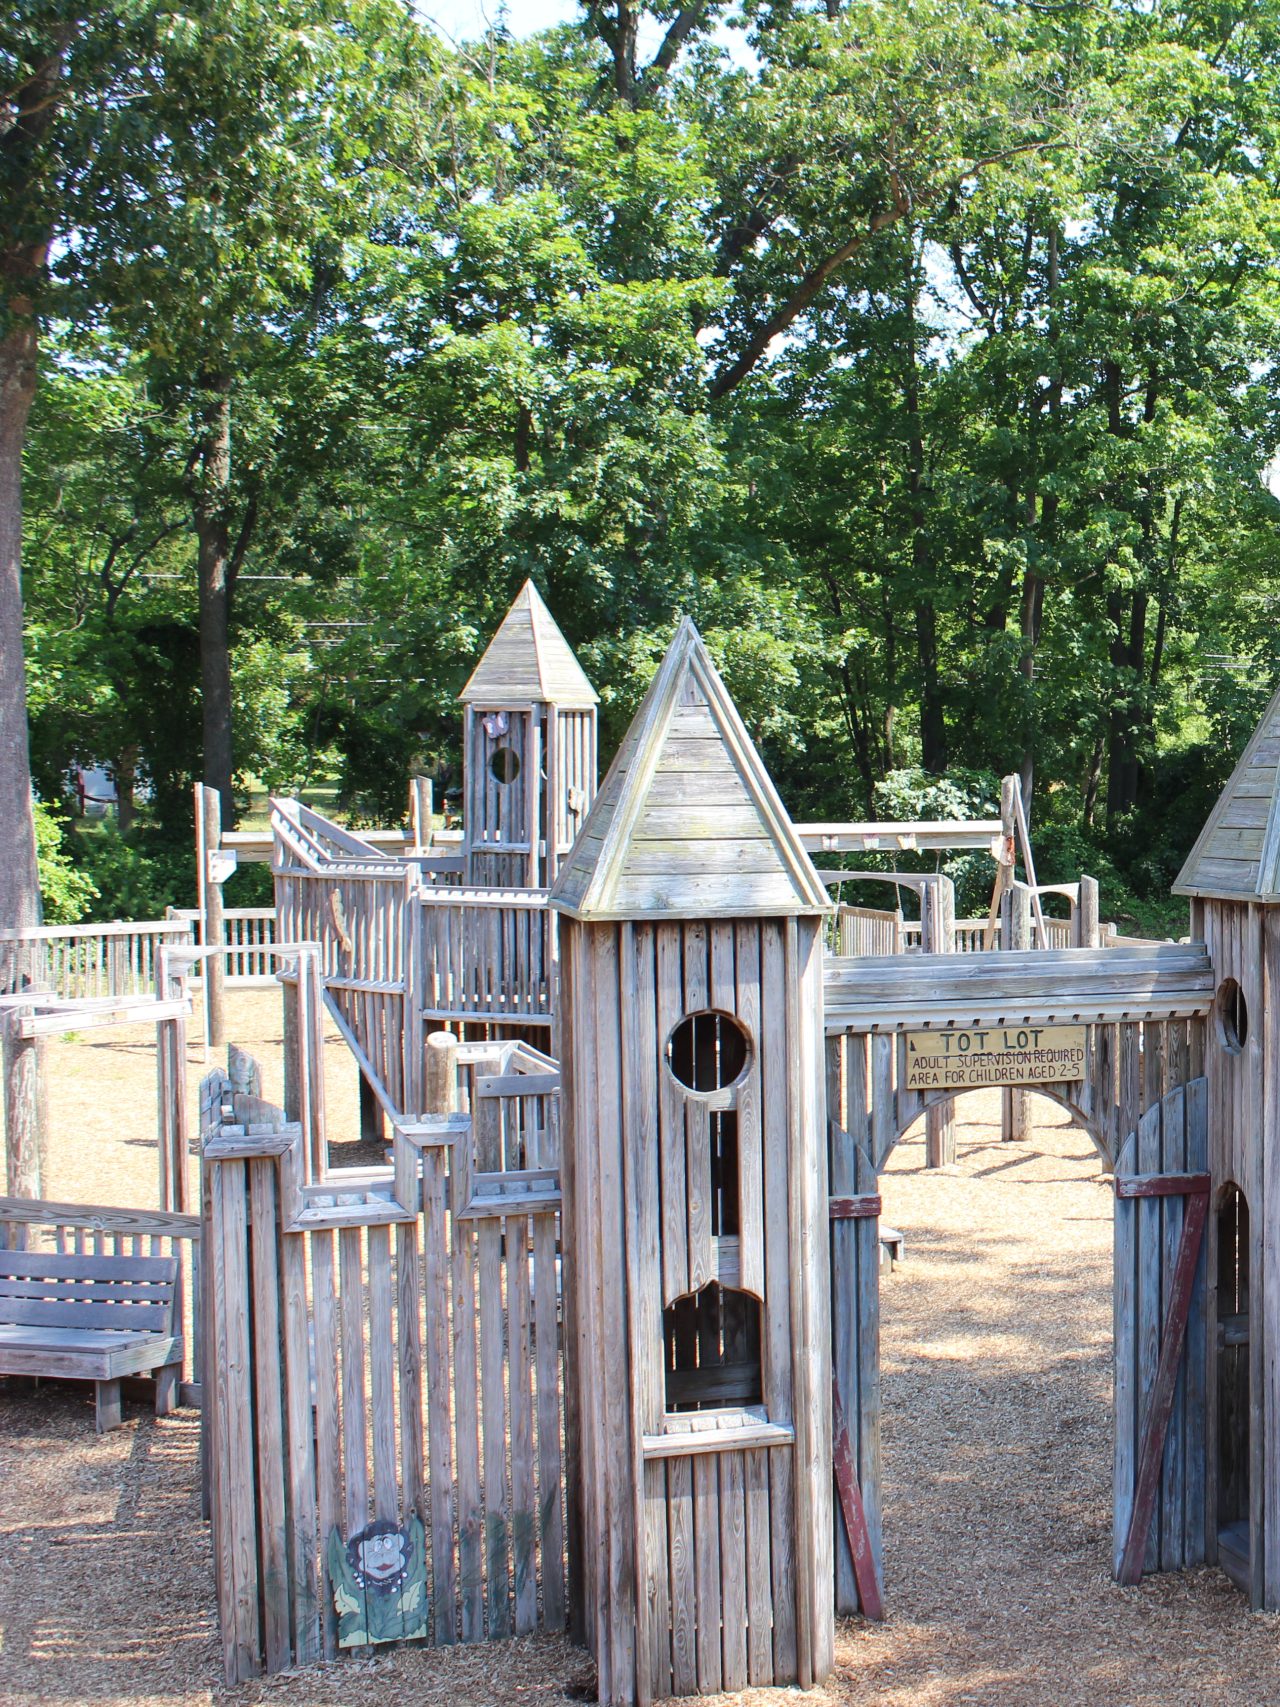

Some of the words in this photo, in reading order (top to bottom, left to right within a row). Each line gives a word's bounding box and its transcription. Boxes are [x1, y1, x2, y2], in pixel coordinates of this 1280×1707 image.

[940, 1032, 989, 1053] TOT
[1003, 1030, 1044, 1049] LOT
[912, 1055, 951, 1069] ADULT
[957, 1050, 1032, 1068] SUPERVISION
[1034, 1048, 1084, 1063] REQUIRED
[909, 1072, 939, 1085] AREA
[944, 1070, 966, 1084] FOR
[968, 1067, 1024, 1083] CHILDREN
[1028, 1065, 1056, 1079] AGED
[1059, 1063, 1080, 1077] 2-5
